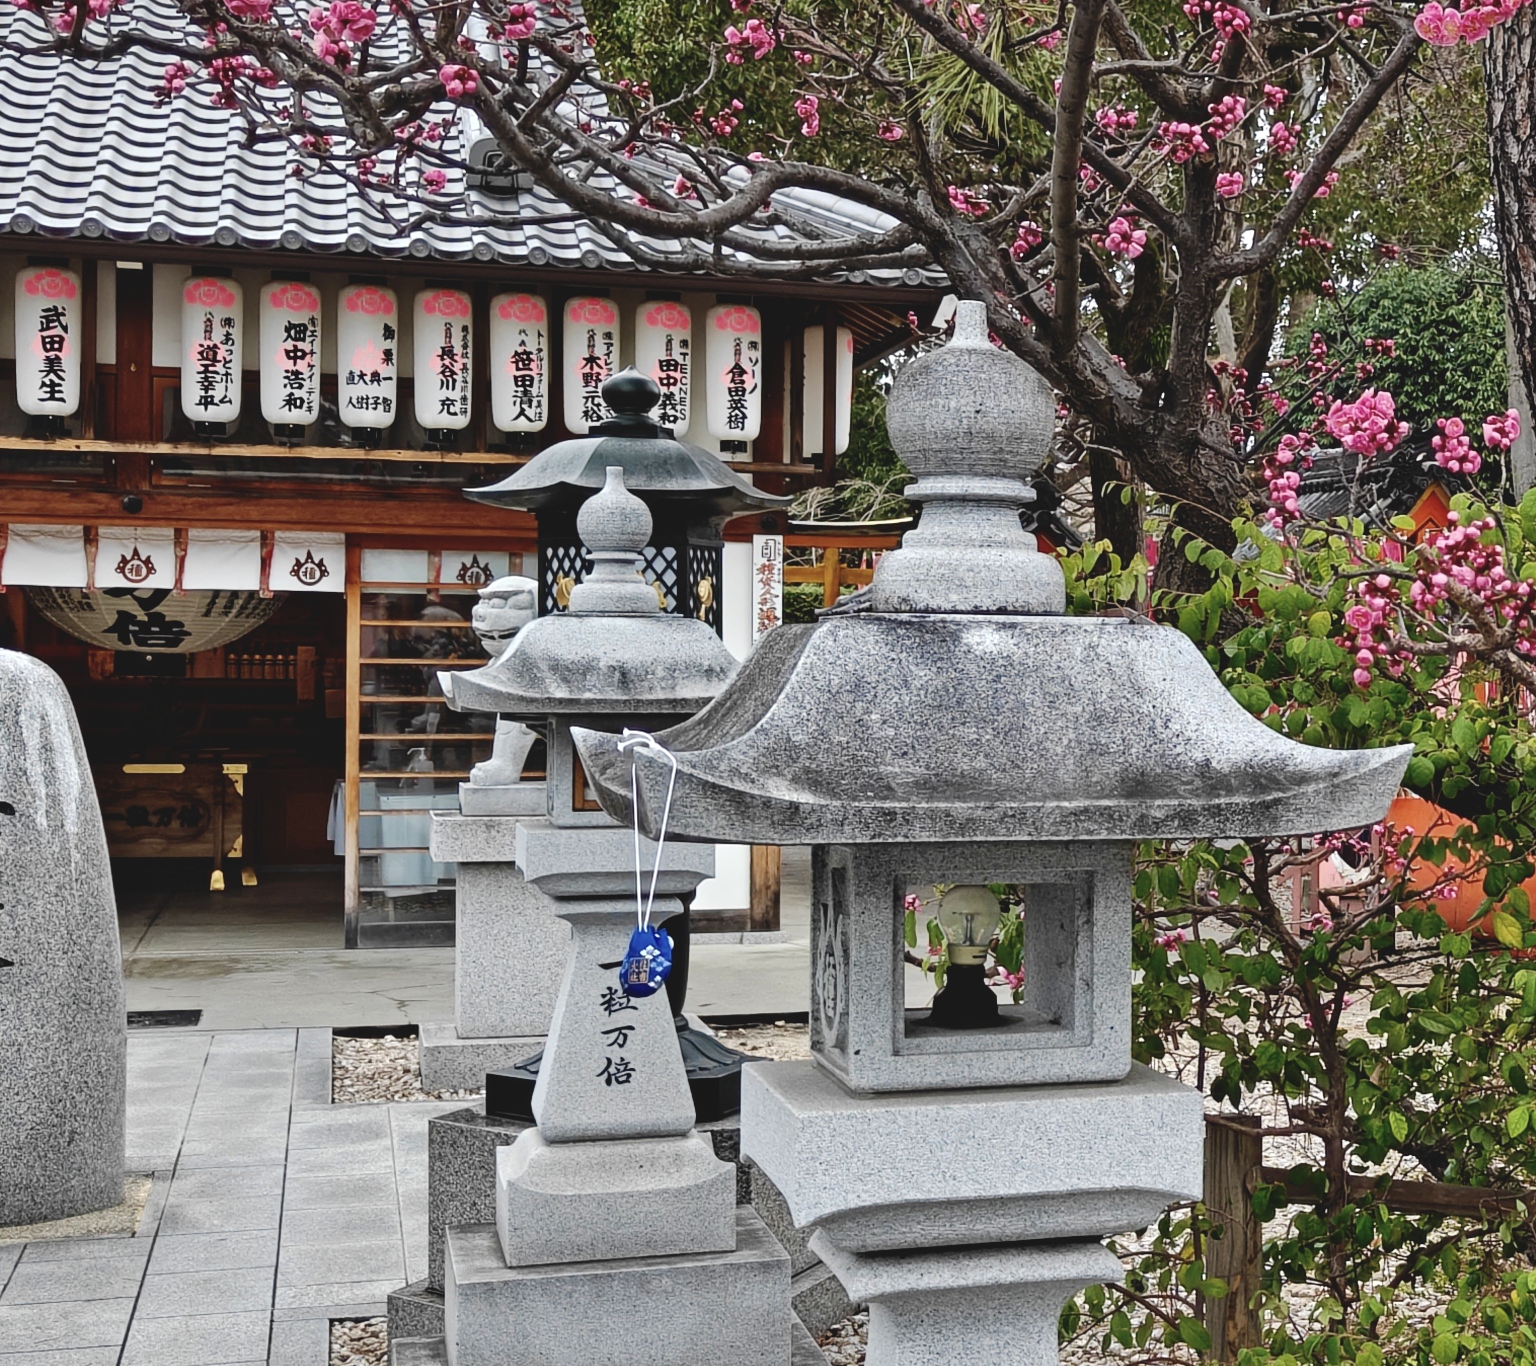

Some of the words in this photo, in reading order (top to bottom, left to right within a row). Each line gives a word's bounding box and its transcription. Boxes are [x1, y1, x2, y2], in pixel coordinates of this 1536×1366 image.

[38, 304, 68, 404] 武田美生
[279, 320, 309, 412] 畑中浩和
[346, 369, 357, 410] 直人
[355, 369, 369, 411] 大樹
[580, 355, 605, 423] 木野元裕
[657, 358, 680, 425] 田中義和
[725, 362, 749, 431] 倉田英樹
